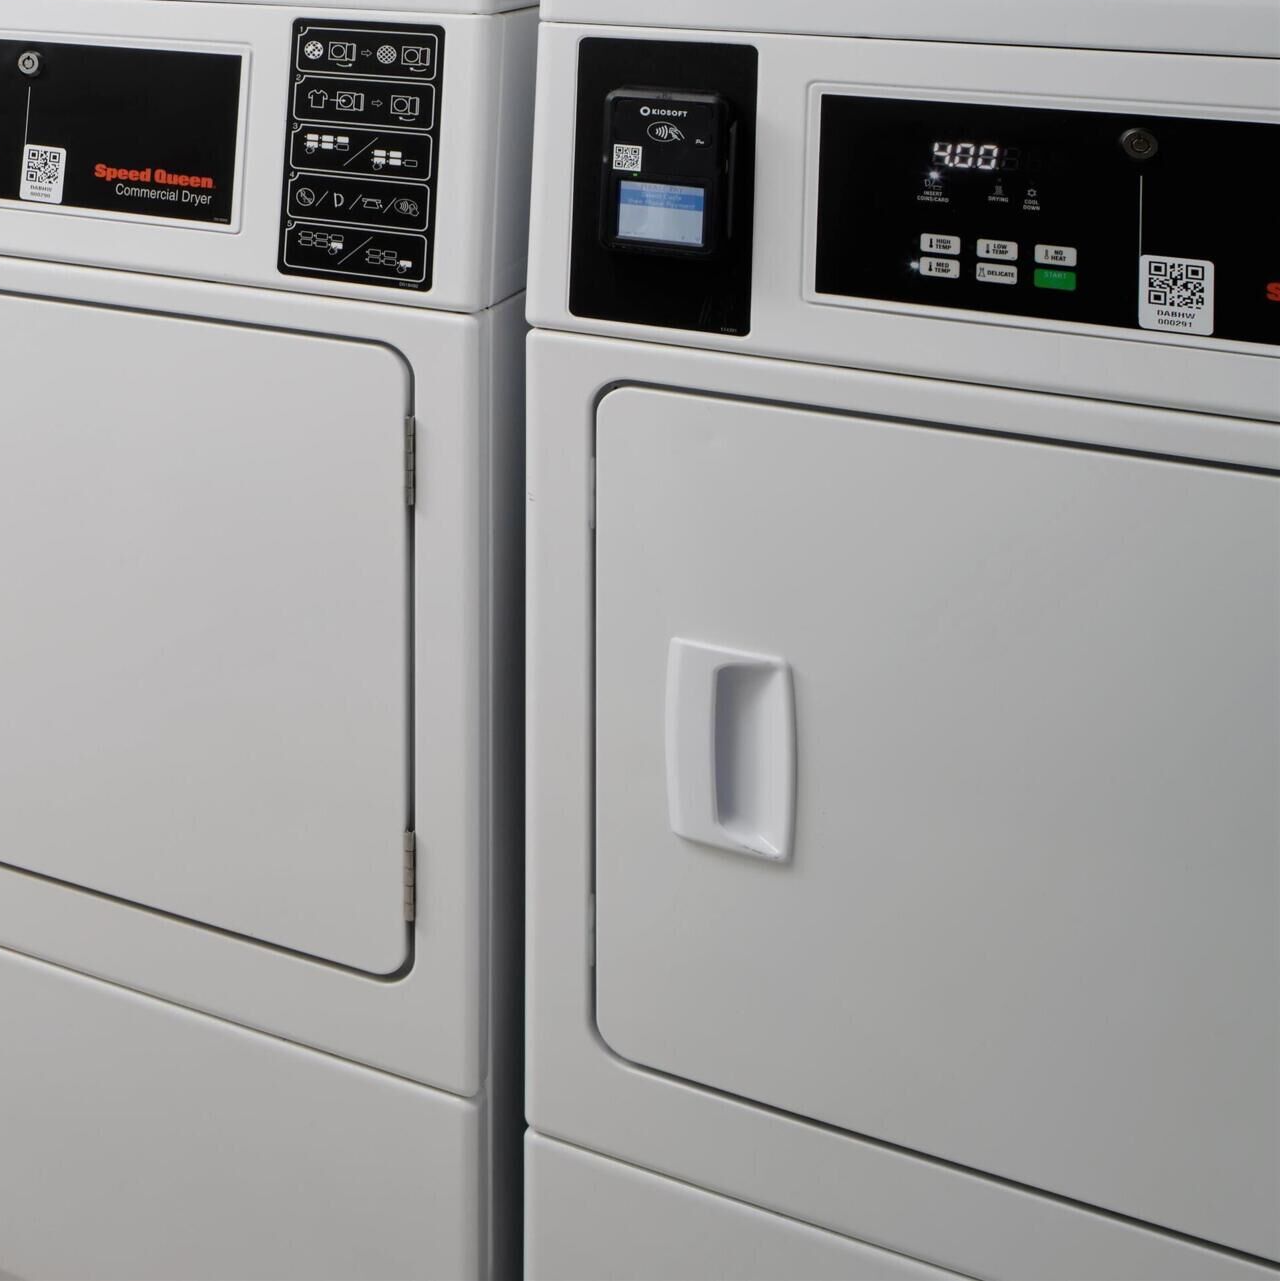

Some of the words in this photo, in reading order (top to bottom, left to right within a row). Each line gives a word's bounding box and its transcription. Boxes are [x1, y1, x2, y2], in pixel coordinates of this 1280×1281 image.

[651, 108, 688, 117] KIOSOFT
[292, 122, 298, 130] 3
[933, 142, 999, 170] 4.00
[94, 163, 151, 182] Speed
[154, 169, 213, 188] Queen
[115, 183, 178, 202] Commercial
[181, 190, 213, 206] Dryer
[917, 195, 949, 203] COINS/CARD
[987, 270, 1015, 278] DELICATE
[1044, 271, 1067, 279] START
[1156, 309, 1196, 320] DABHW
[1158, 318, 1193, 328] 000291
